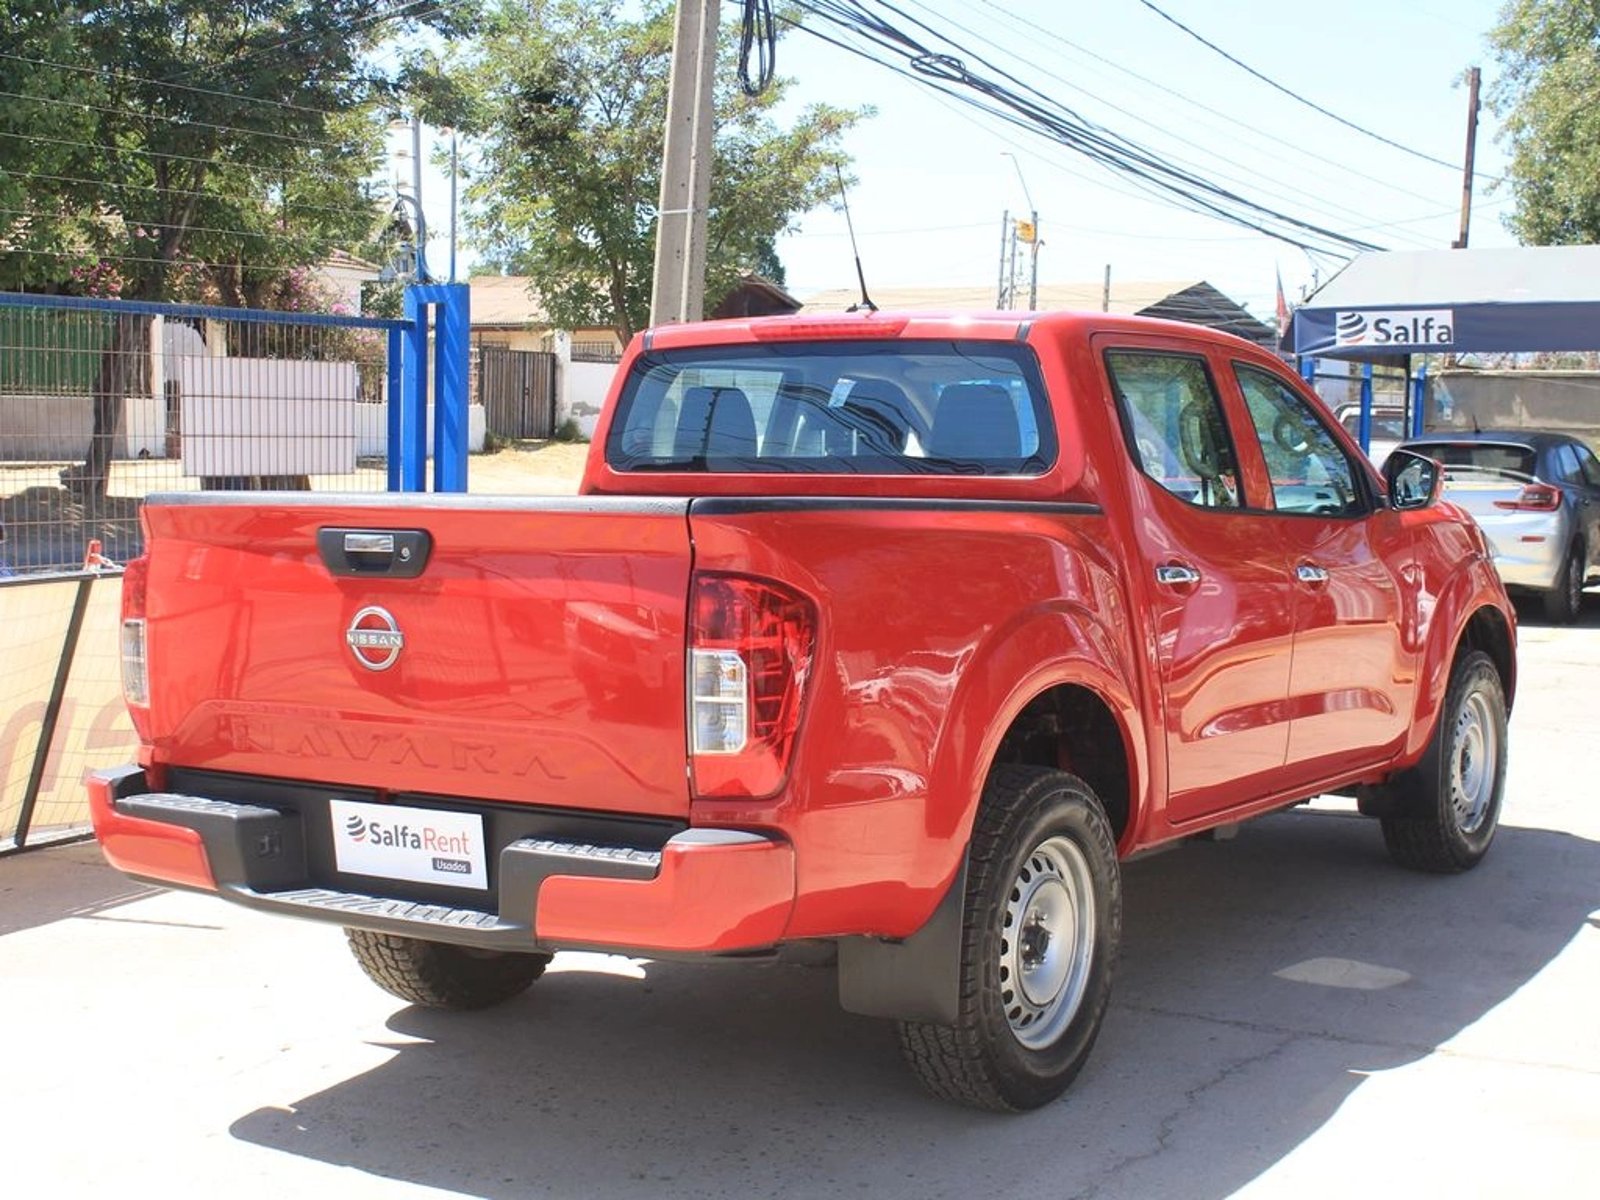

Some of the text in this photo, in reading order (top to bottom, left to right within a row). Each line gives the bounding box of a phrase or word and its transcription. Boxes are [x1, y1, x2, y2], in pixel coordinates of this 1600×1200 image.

[1373, 317, 1453, 343] Salfa
[346, 632, 401, 645] NISSAN
[233, 719, 568, 781] NAVARA
[369, 821, 471, 855] SalfaRent
[436, 857, 467, 873] Usados
